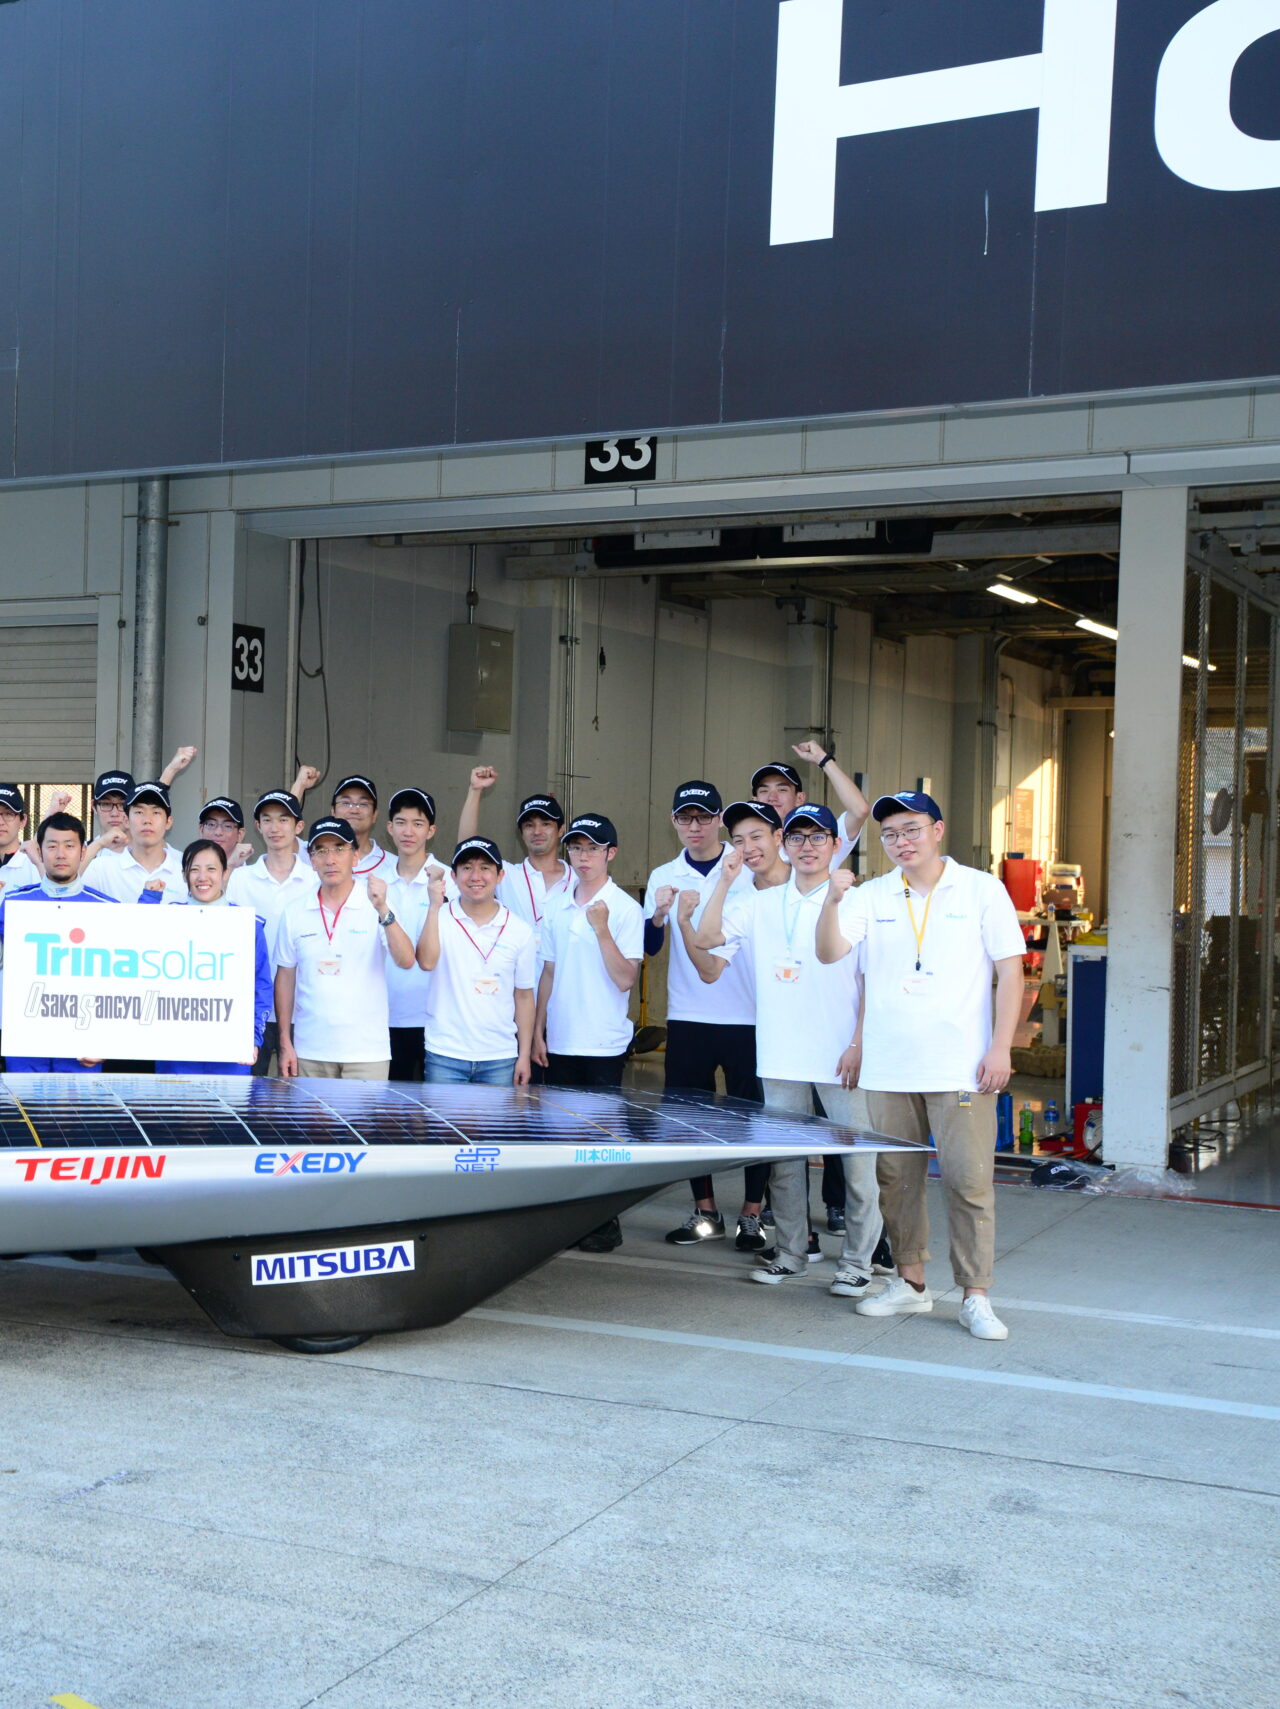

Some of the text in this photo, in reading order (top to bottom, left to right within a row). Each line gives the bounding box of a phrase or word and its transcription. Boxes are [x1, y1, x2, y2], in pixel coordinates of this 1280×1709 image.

[589, 437, 652, 472] 33
[234, 636, 263, 682] 33
[102, 777, 128, 785] EXEDY
[679, 788, 710, 798] EXEDY
[524, 799, 551, 810] EXEDY
[316, 821, 342, 830] EXEDY
[572, 819, 602, 828] EXEDY
[254, 1151, 368, 1176] EXEDY
[455, 1163, 500, 1172] NET
[15, 1154, 167, 1185] TEIJIN
[255, 1245, 411, 1281] MITSUBA
